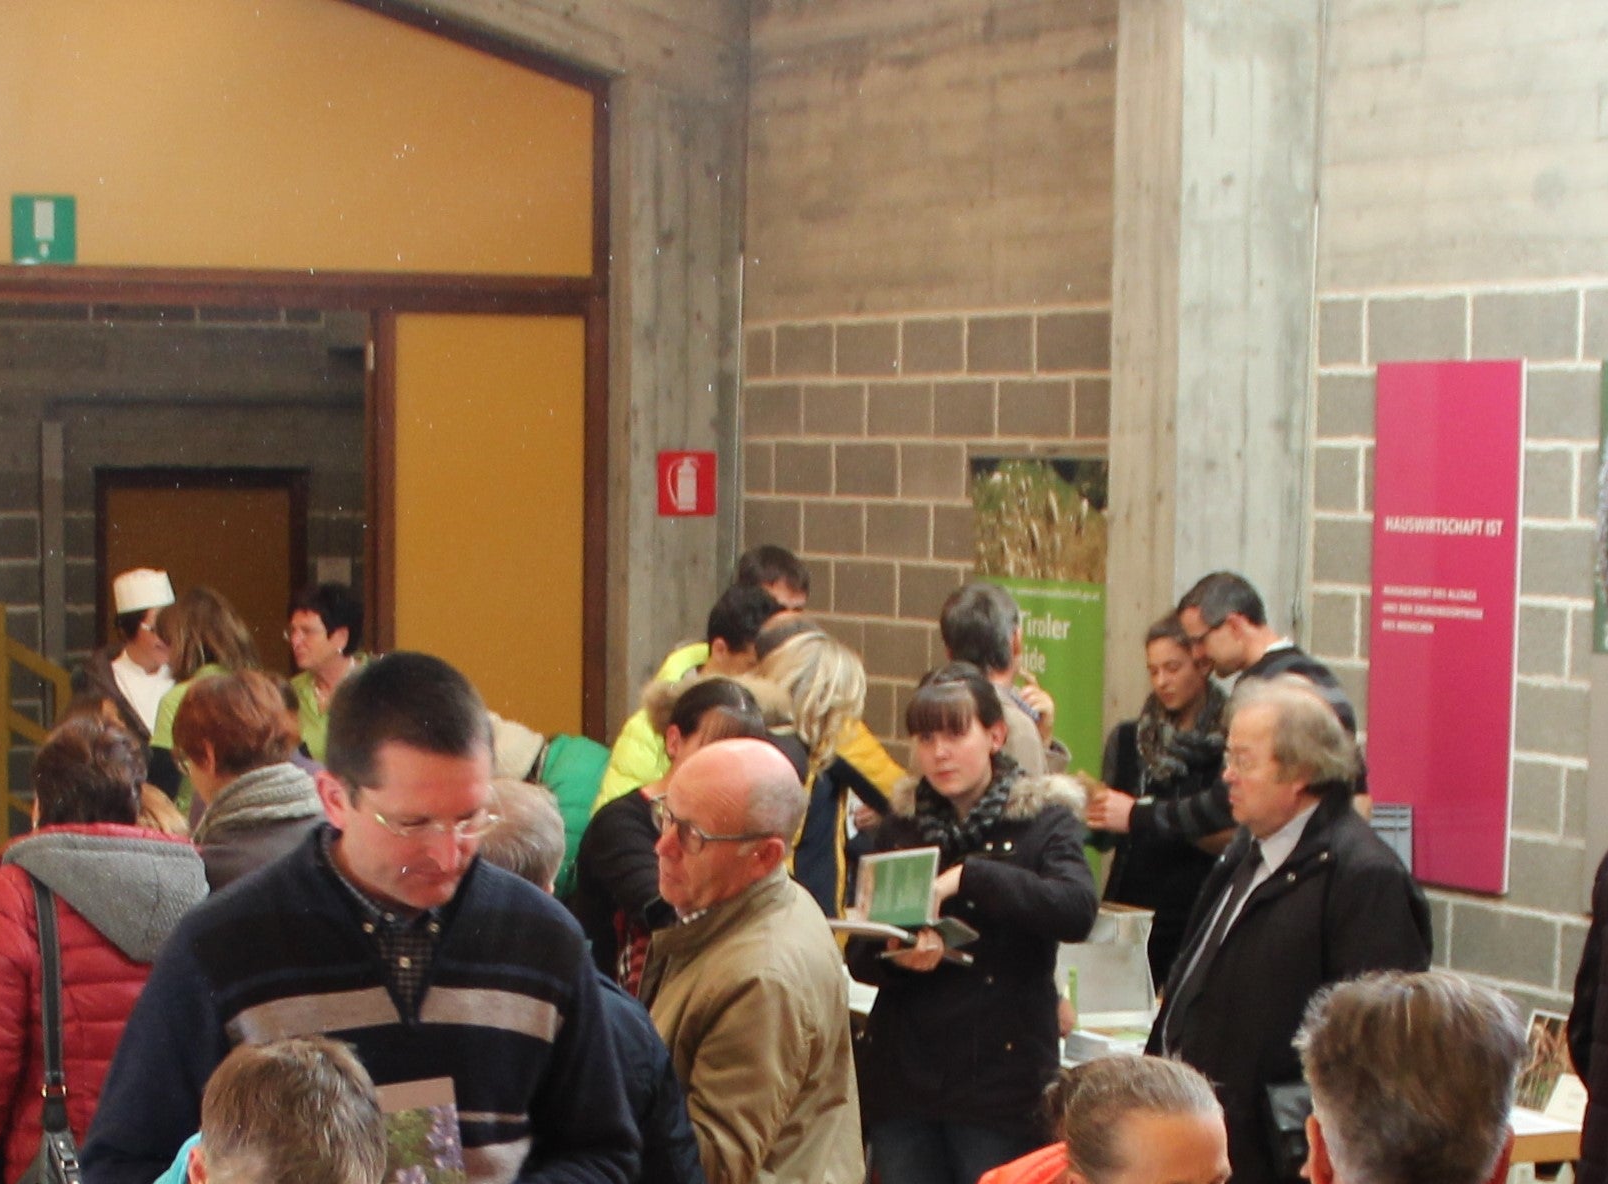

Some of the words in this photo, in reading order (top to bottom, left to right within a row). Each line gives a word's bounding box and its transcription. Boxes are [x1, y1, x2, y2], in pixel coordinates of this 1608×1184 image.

[1385, 516, 1483, 536] HAUSWIRTSCHAFT
[1485, 518, 1503, 537] IST
[1019, 610, 1070, 639] Tiroler
